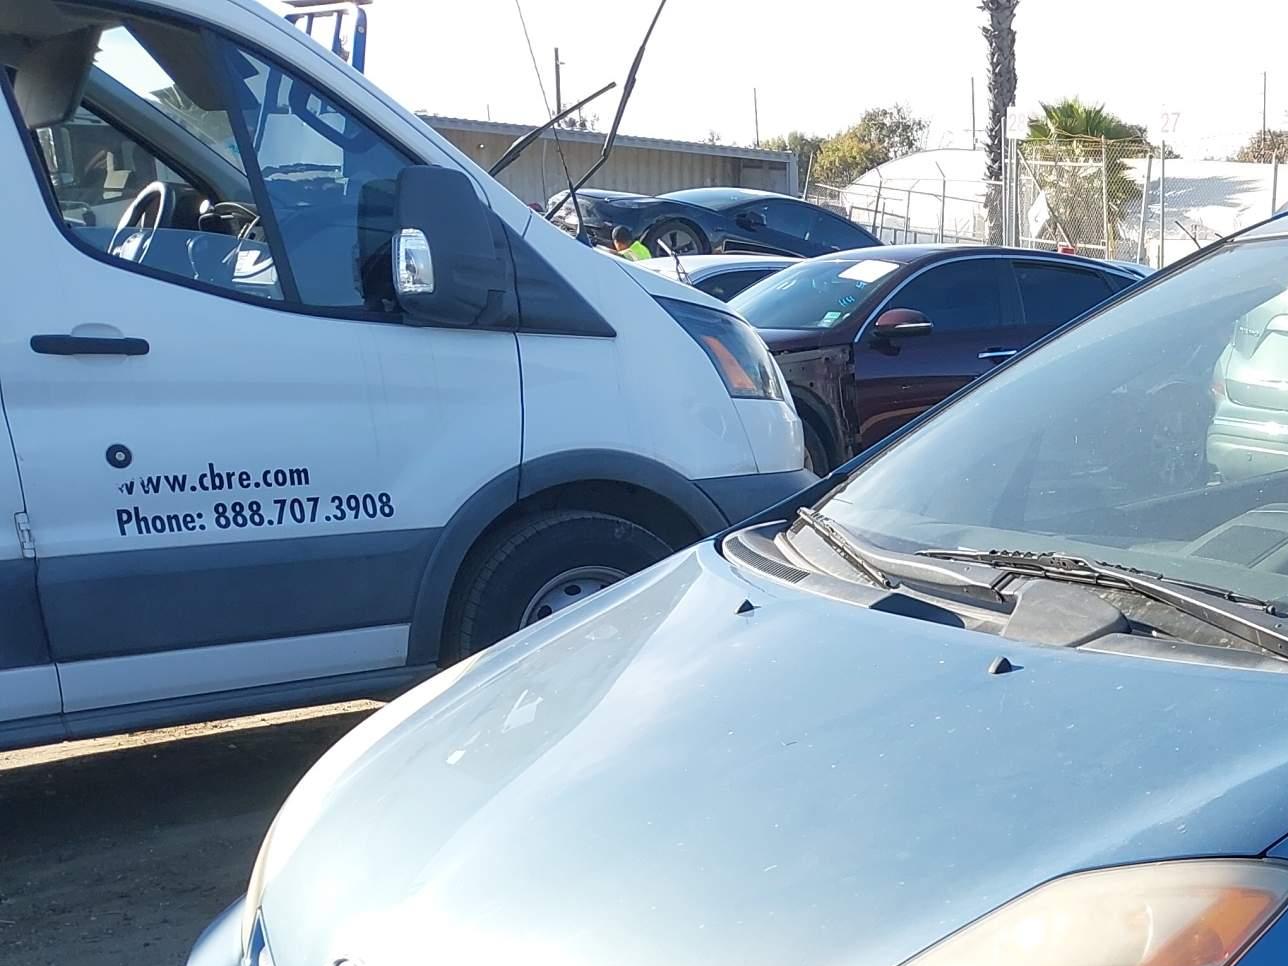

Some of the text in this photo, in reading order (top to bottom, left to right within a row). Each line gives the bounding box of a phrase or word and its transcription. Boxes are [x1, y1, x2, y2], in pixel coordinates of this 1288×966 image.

[1160, 112, 1181, 134] 27
[116, 492, 395, 536] Phone: 888.707.3908
